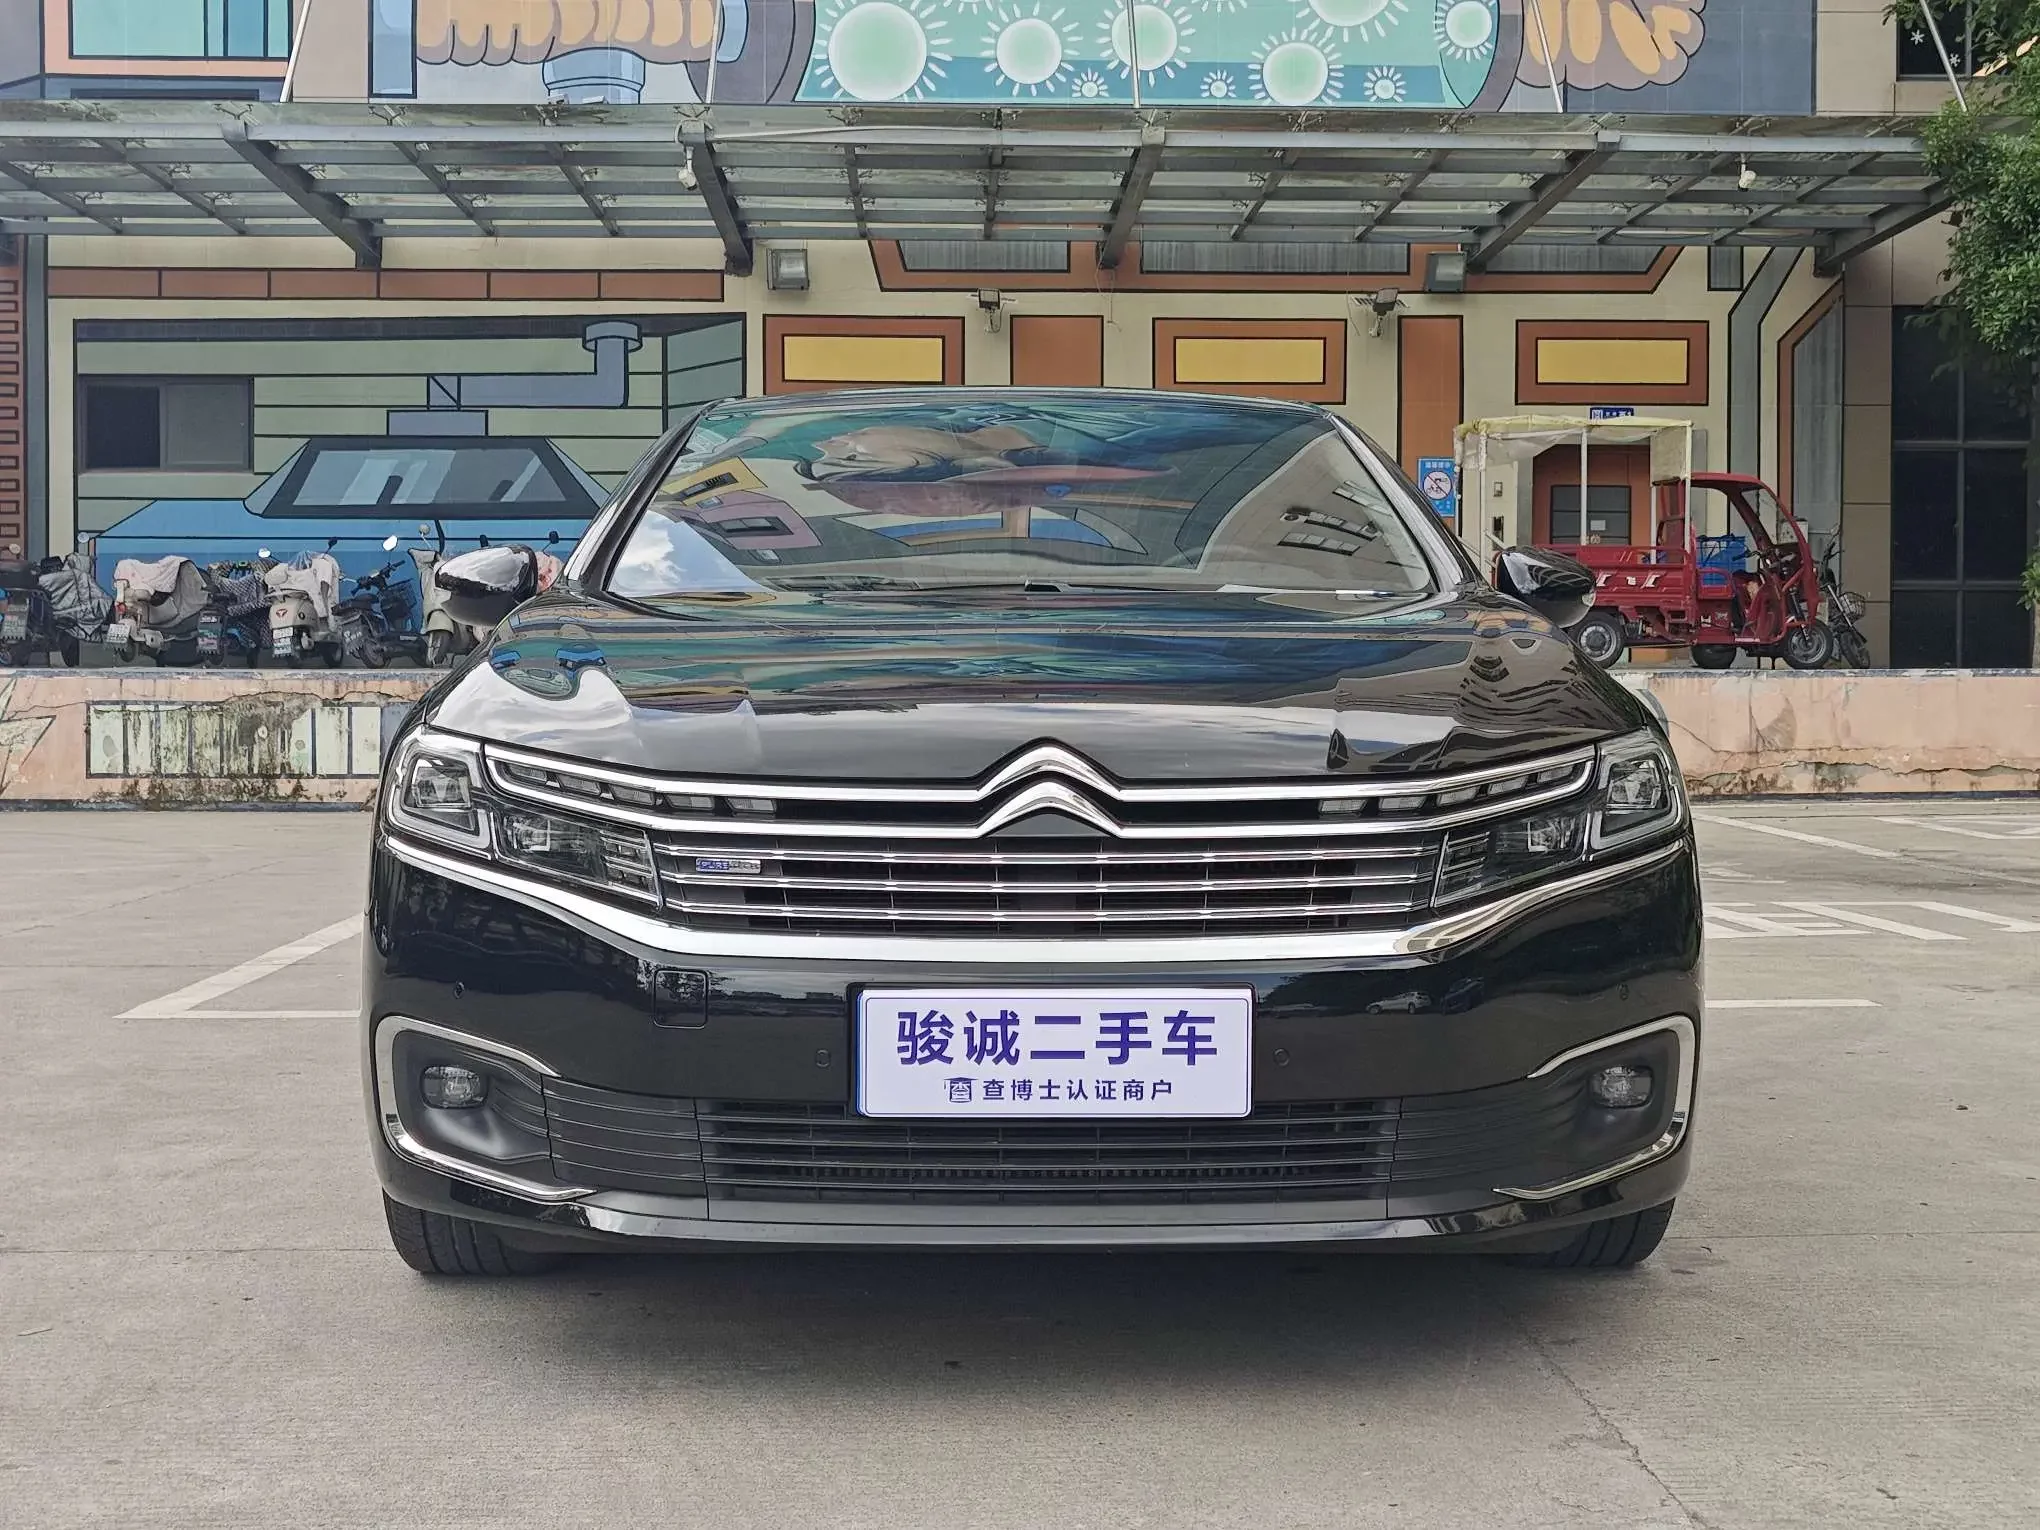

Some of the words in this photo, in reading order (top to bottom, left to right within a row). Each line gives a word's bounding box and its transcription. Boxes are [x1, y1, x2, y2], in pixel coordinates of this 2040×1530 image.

[897, 1010, 1218, 1066] 骏诚二手车
[982, 1079, 1172, 1101] 查博士认证商户
